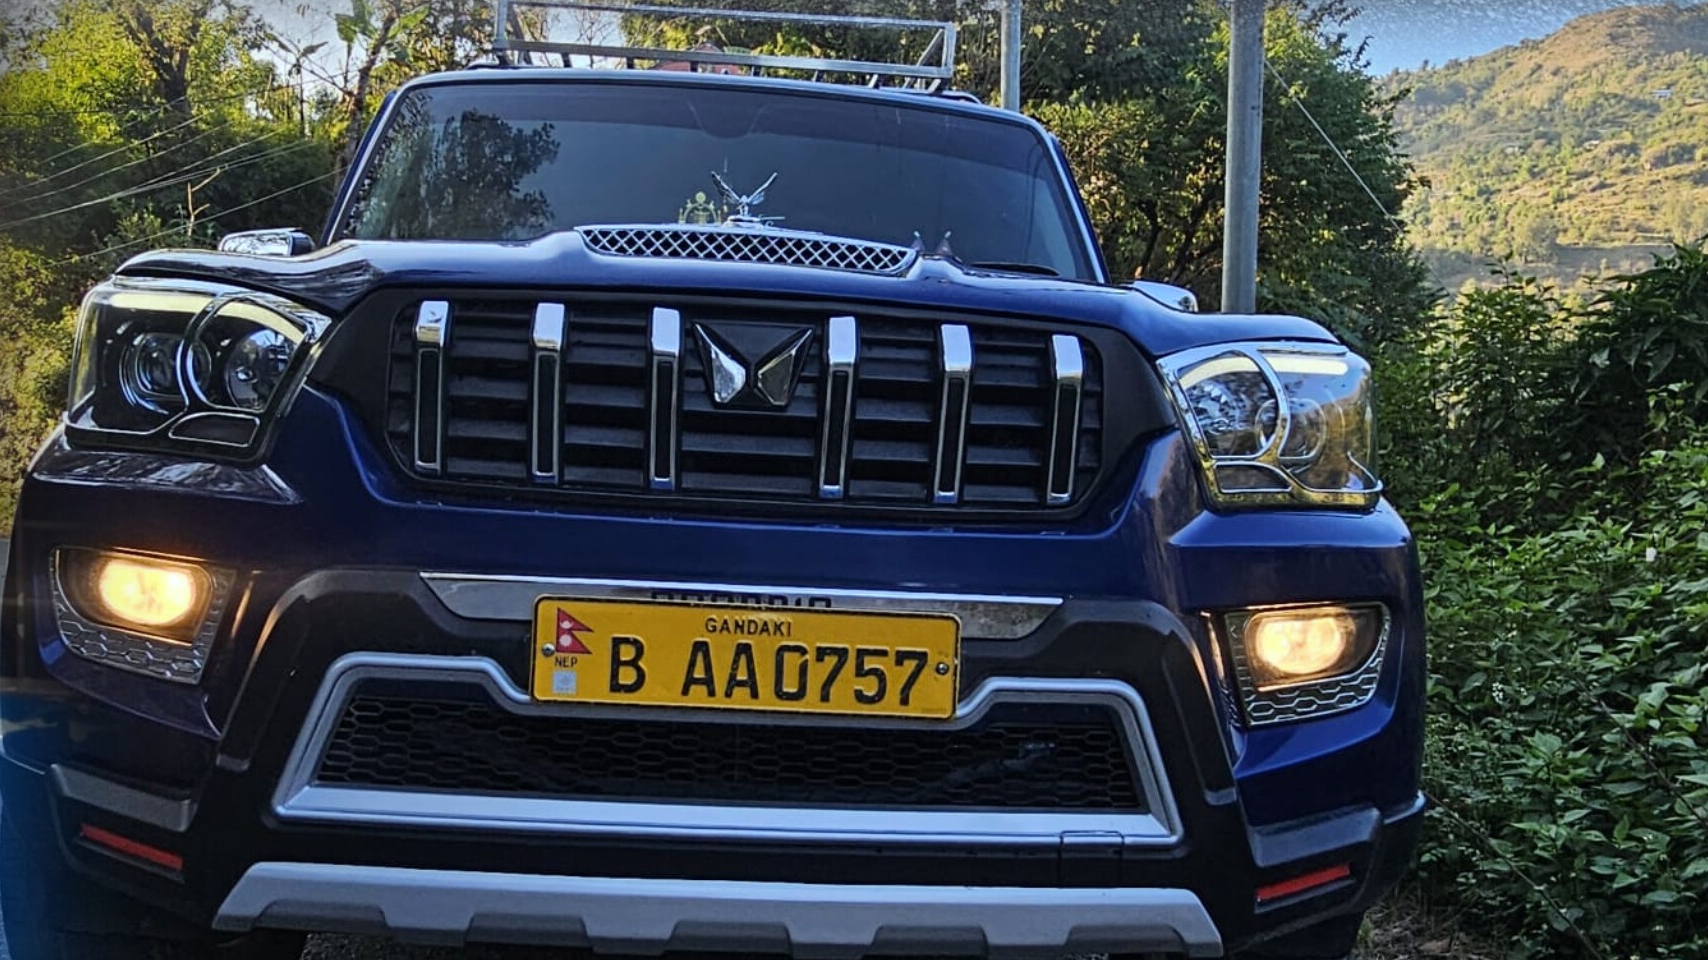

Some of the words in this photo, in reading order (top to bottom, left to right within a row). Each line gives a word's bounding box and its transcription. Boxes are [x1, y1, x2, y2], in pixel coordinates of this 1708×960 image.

[705, 617, 792, 637] GANDAKI
[555, 656, 578, 668] NEP
[609, 635, 646, 694] B
[681, 639, 929, 707] AA0757
